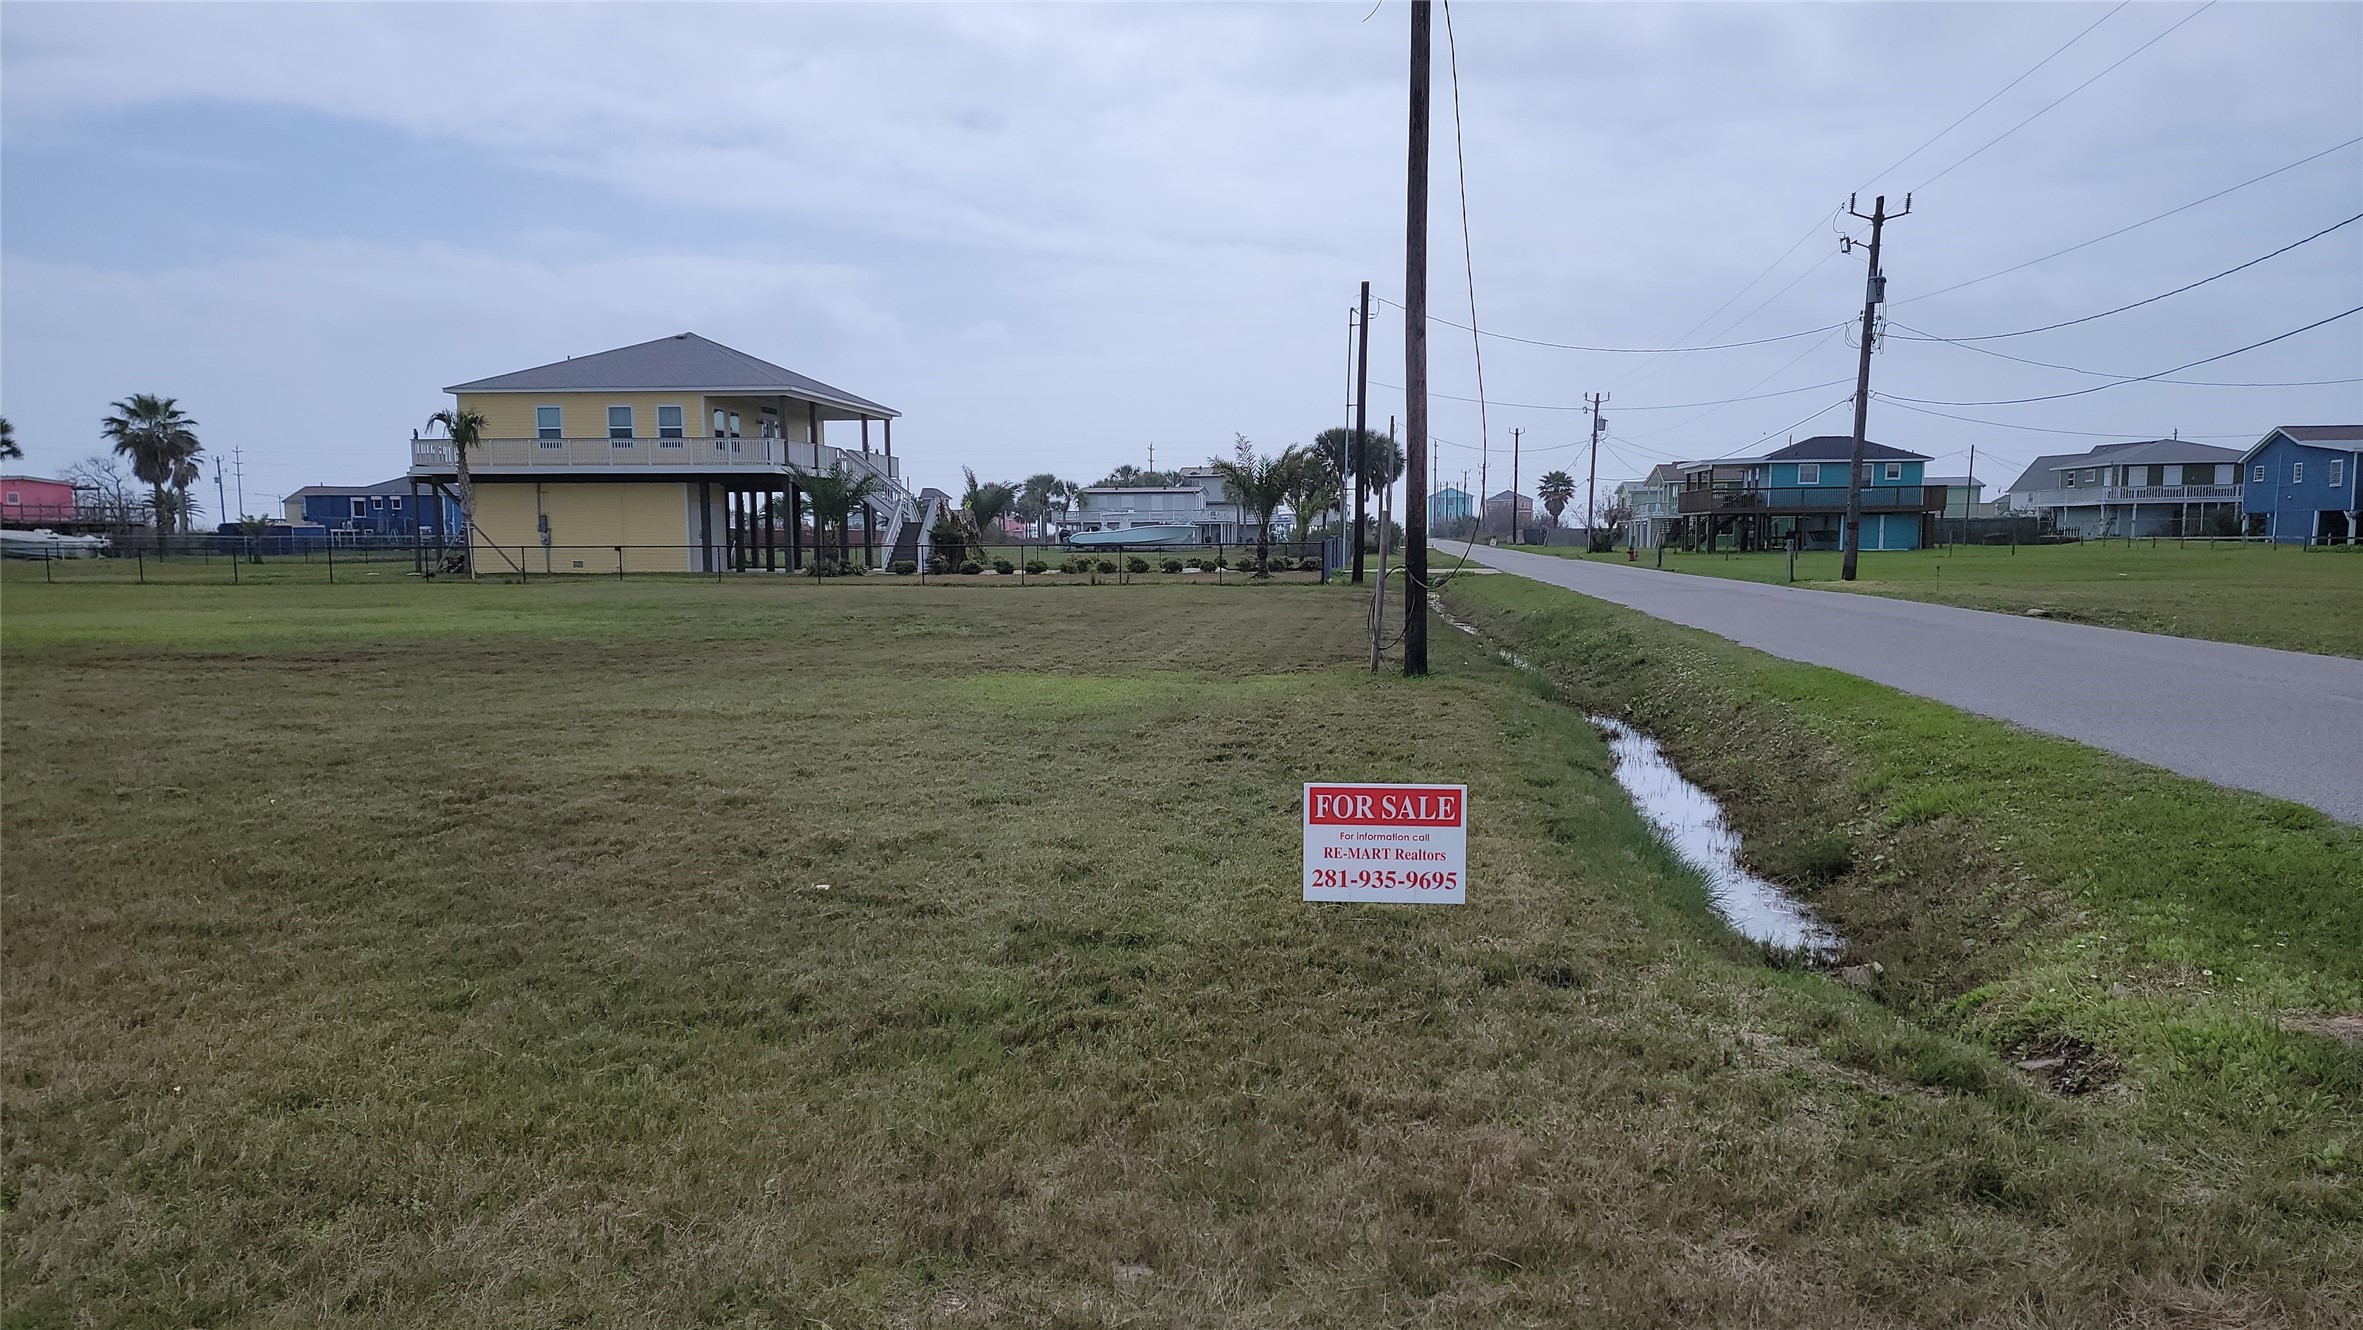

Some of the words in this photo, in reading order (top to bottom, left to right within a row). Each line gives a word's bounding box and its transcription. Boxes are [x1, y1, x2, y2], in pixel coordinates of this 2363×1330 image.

[1315, 794, 1375, 819] FOR
[1381, 795, 1456, 820] SALE
[1340, 832, 1354, 841] For
[1356, 832, 1410, 842] information
[1412, 833, 1430, 842] call
[1324, 847, 1391, 860] RE-MART
[1395, 848, 1446, 861] Realtors
[1312, 869, 1457, 890] 281-935-9695
